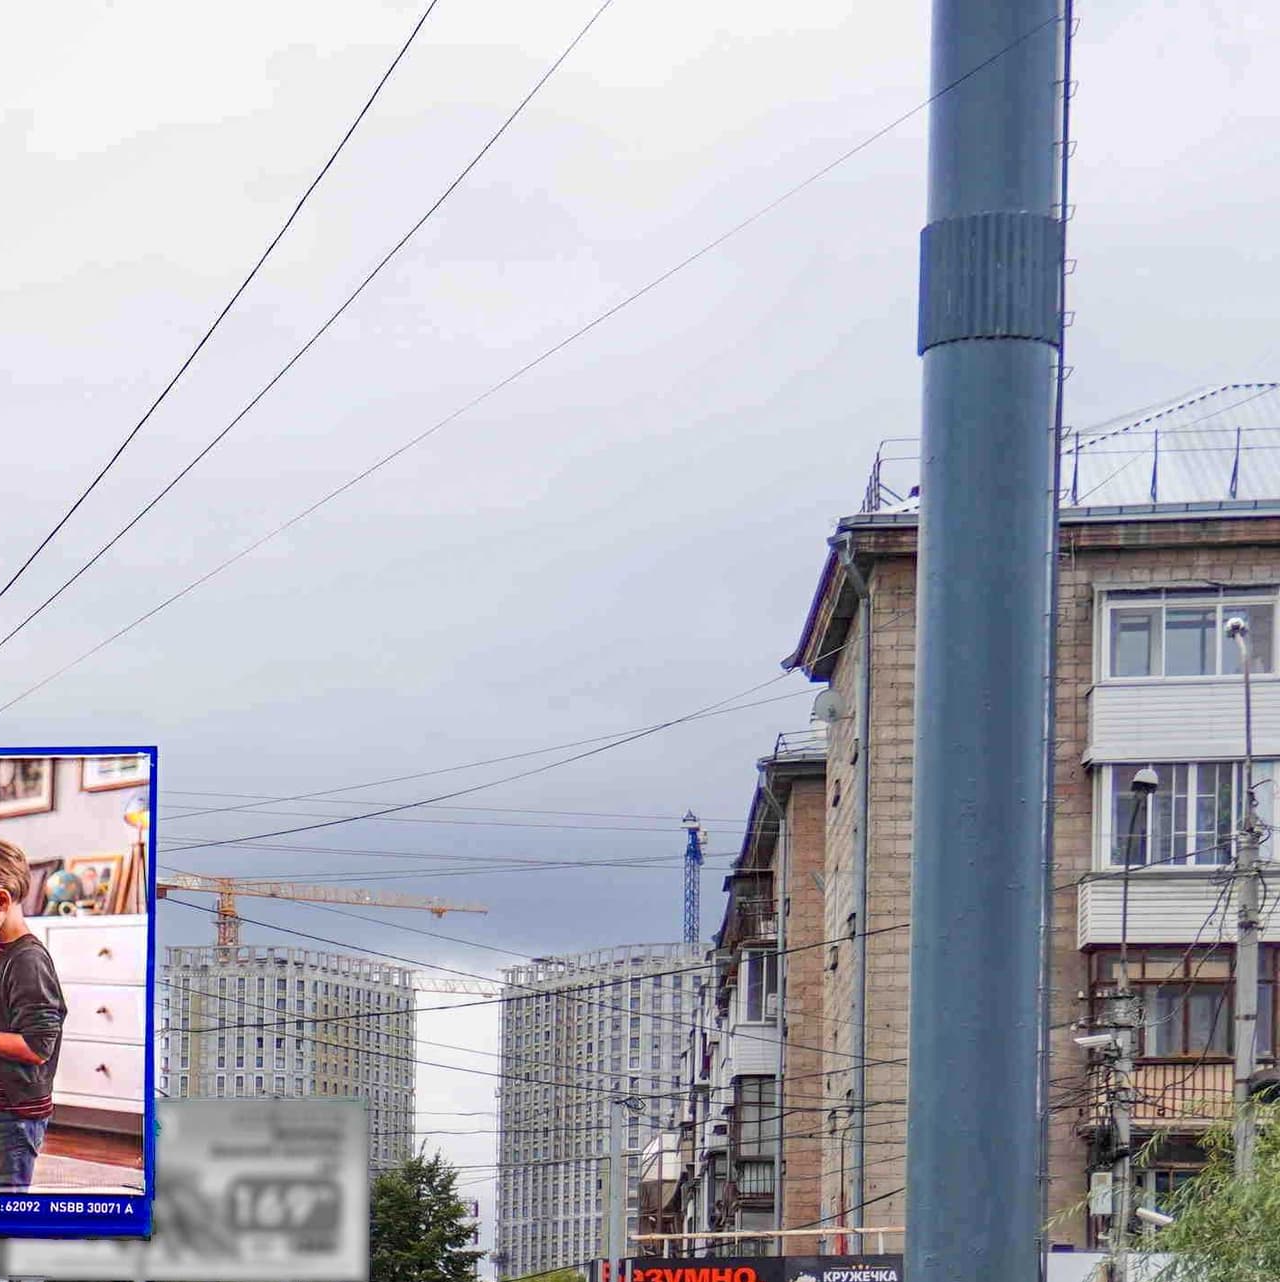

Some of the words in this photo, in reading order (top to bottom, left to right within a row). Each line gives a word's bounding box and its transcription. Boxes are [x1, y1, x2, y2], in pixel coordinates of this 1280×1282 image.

[50, 1202, 84, 1213] NSBB
[87, 1203, 121, 1214] 30071
[823, 1270, 898, 1282] КРУЖЕЧКА
